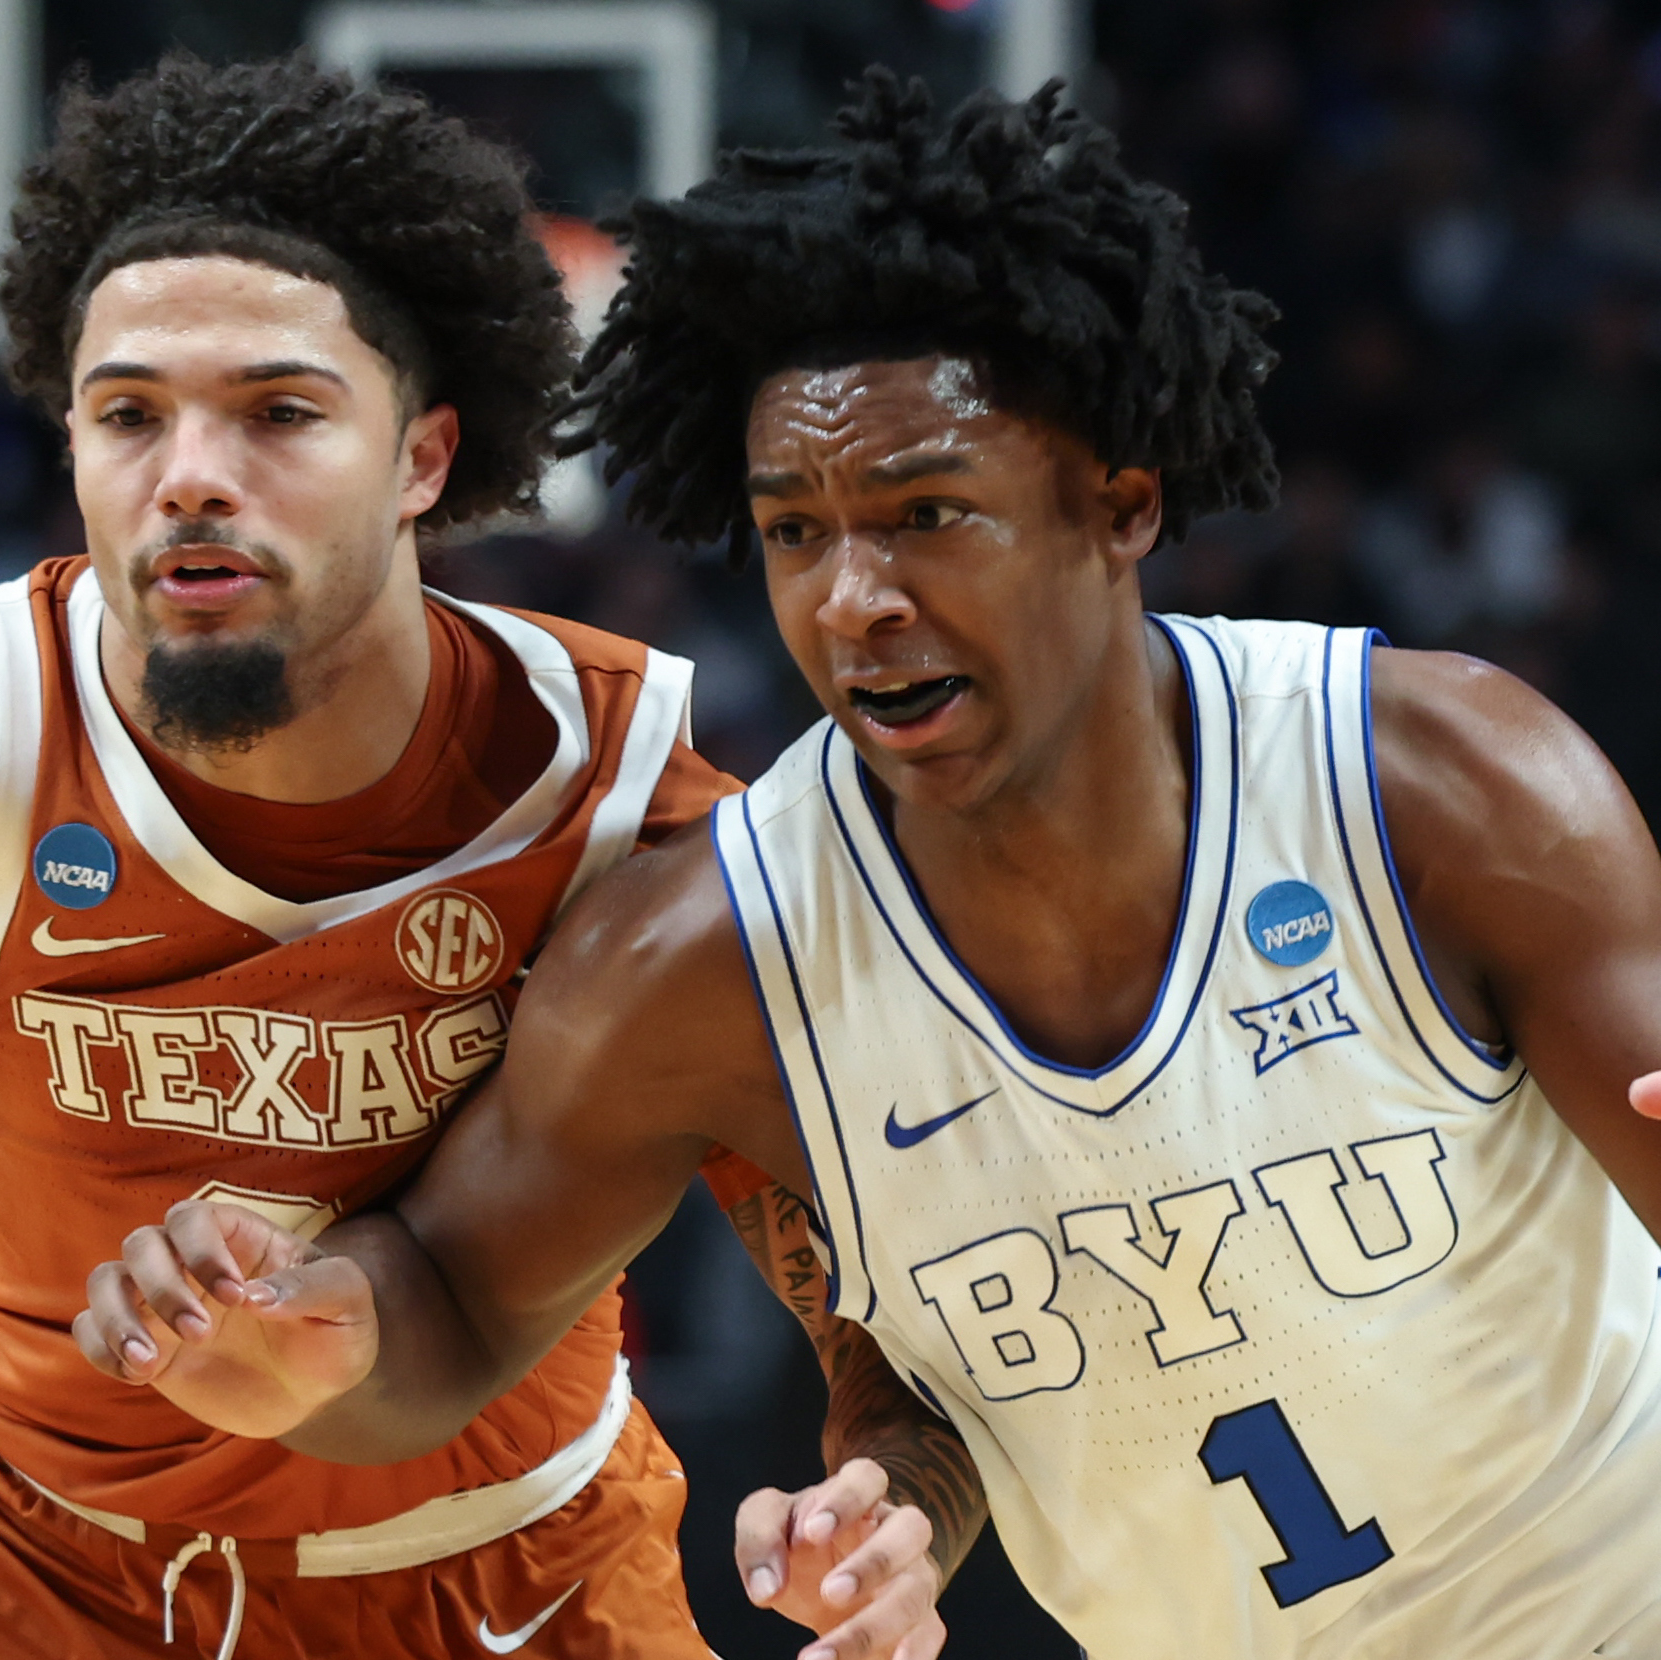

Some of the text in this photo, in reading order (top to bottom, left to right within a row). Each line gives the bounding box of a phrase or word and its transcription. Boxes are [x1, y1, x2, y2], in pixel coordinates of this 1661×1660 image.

[42, 860, 111, 892] NCAA
[1261, 909, 1331, 952] NCAA
[405, 897, 496, 987] SEC
[11, 989, 511, 1153] TEXAS
[1229, 967, 1362, 1078] XII
[909, 1127, 1459, 1402] BYU
[1197, 1398, 1395, 1609] 1
